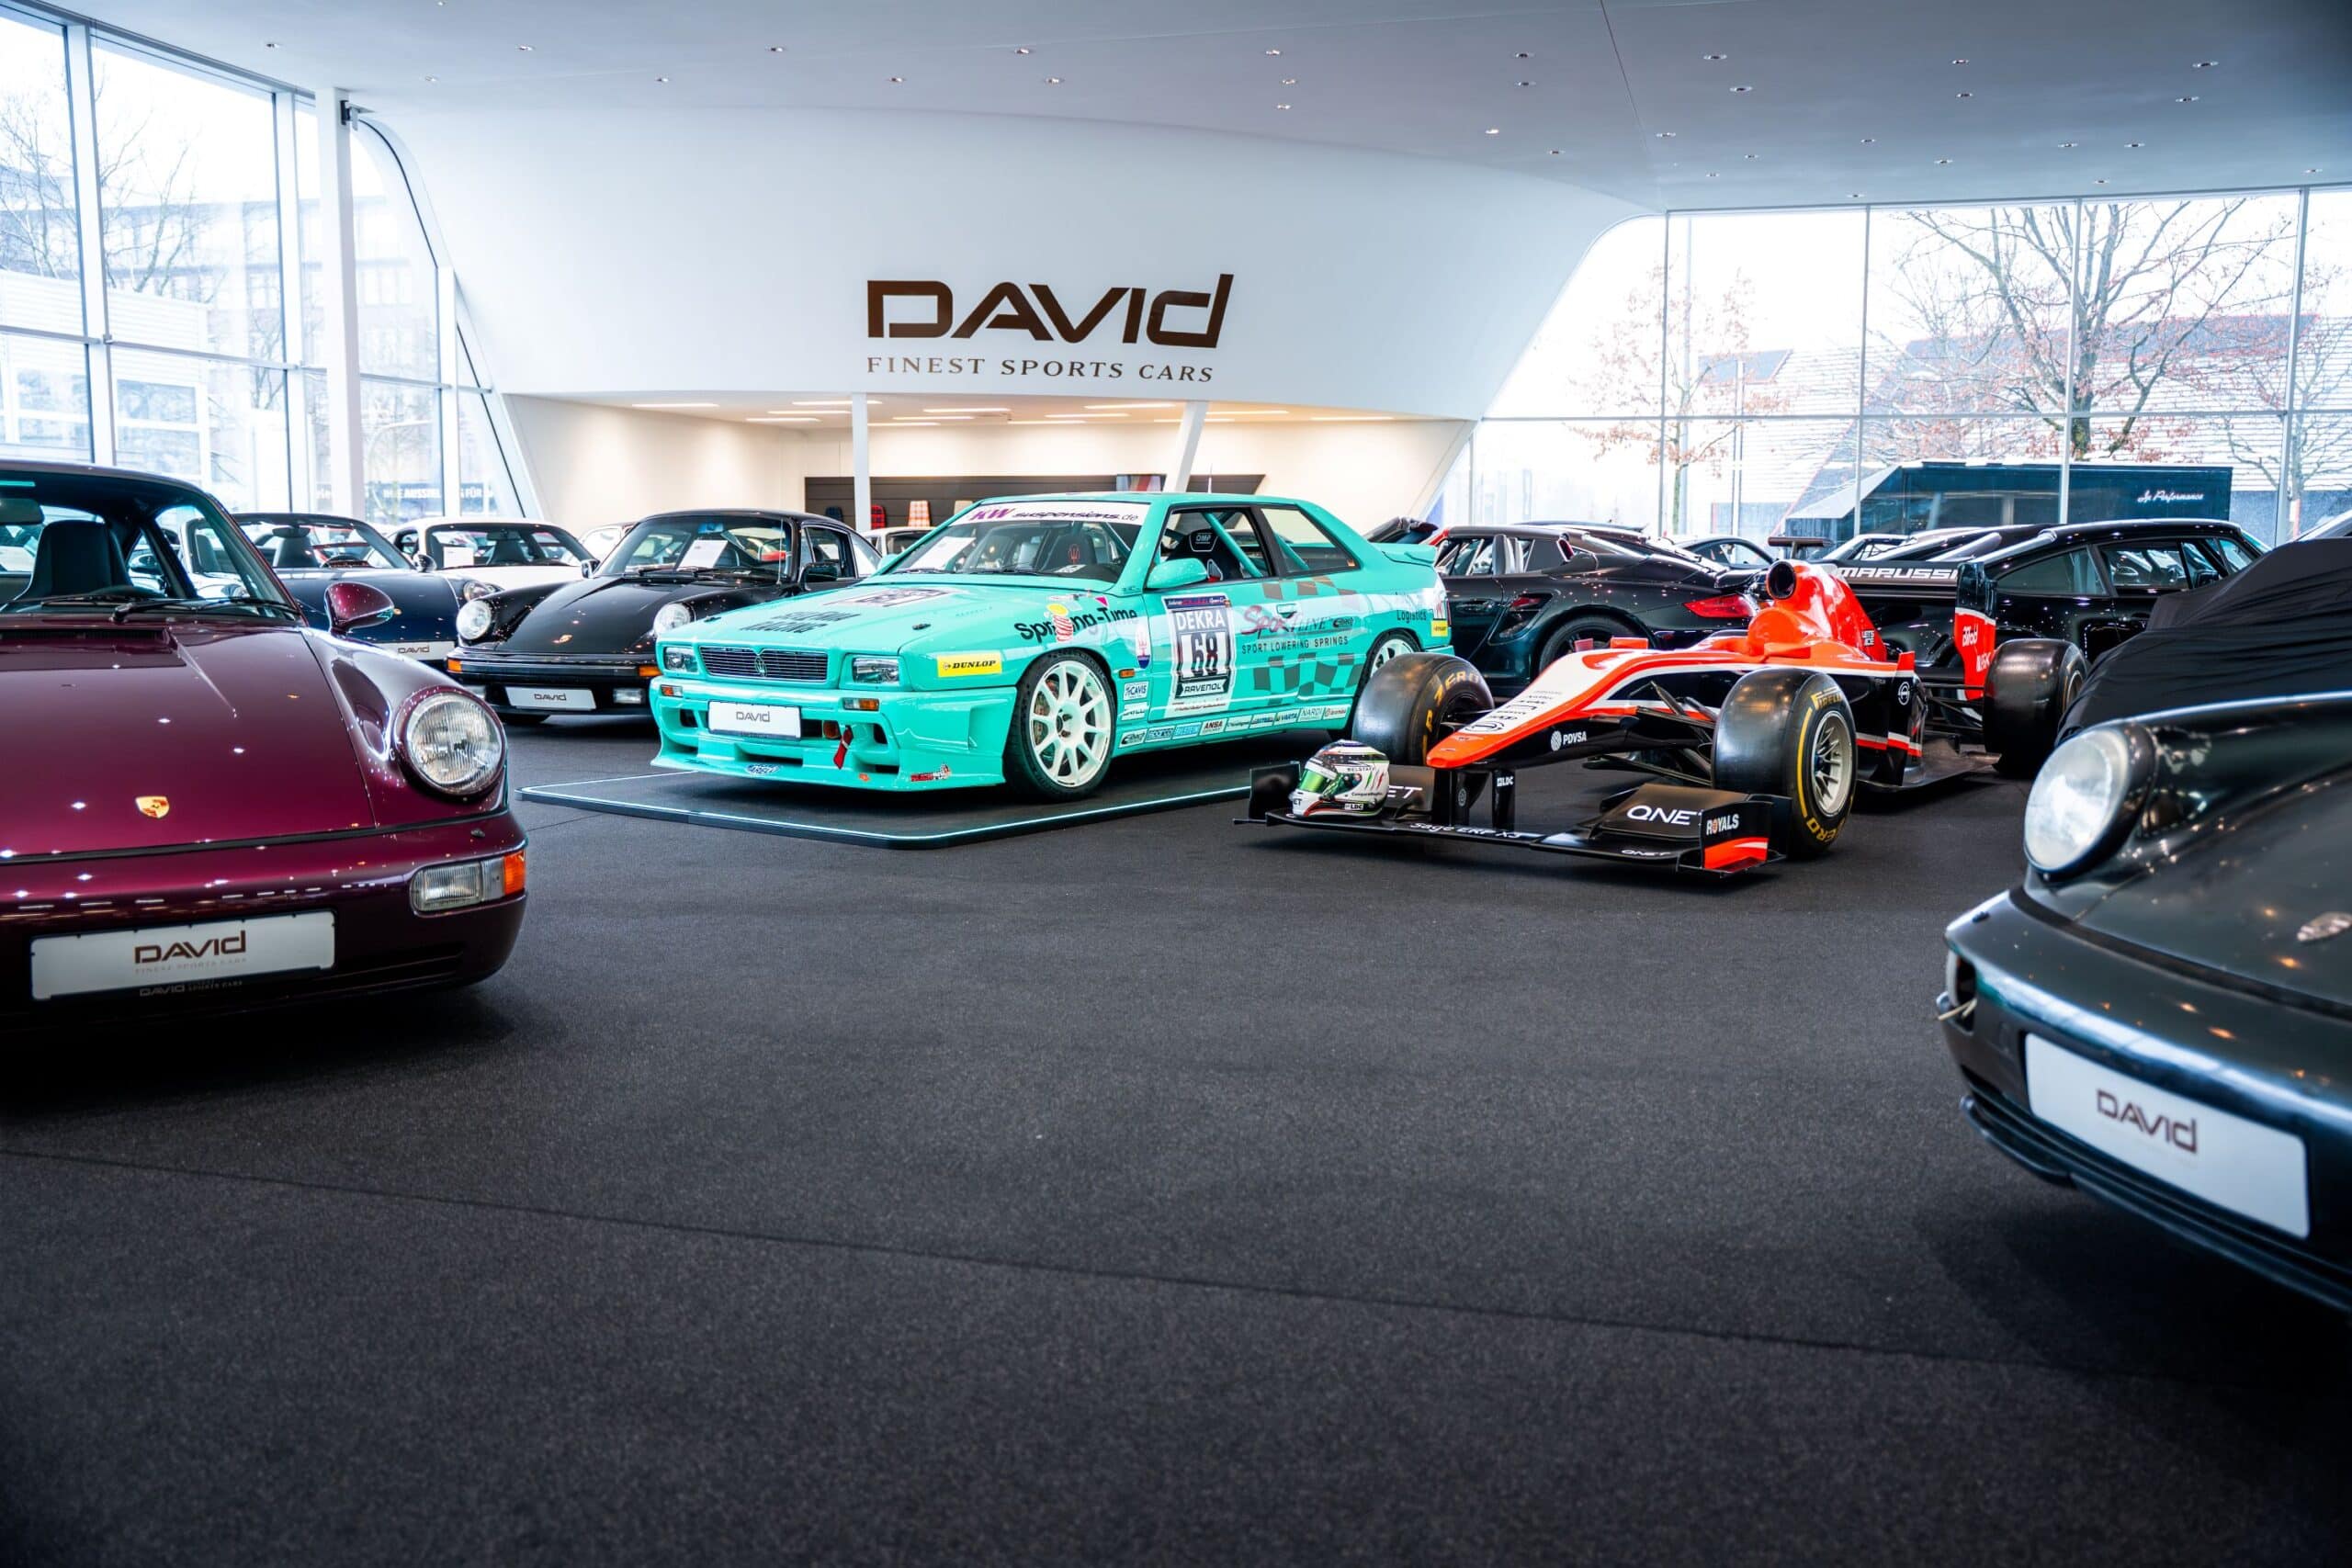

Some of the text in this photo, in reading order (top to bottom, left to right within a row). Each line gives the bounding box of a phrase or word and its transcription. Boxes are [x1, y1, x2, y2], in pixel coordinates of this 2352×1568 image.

[866, 356, 1214, 382] FINEST SPORTS CARS
[969, 508, 1138, 521] KW suspensions.de
[1838, 567, 1958, 580] MARUSSI
[1174, 609, 1227, 631] DEKRA
[1396, 610, 1427, 624] Logistics
[1242, 636, 1349, 654] SPORT LOWERING SPRINGS
[1191, 632, 1218, 676] 68
[952, 660, 997, 669] DUNLOP
[1204, 720, 1224, 729] ANSA
[1563, 731, 1588, 745] PDVSA
[1387, 785, 1422, 798] ET
[1626, 805, 1702, 826] QNE
[1410, 822, 1454, 831] Sage
[1706, 814, 1739, 836] ROYALS
